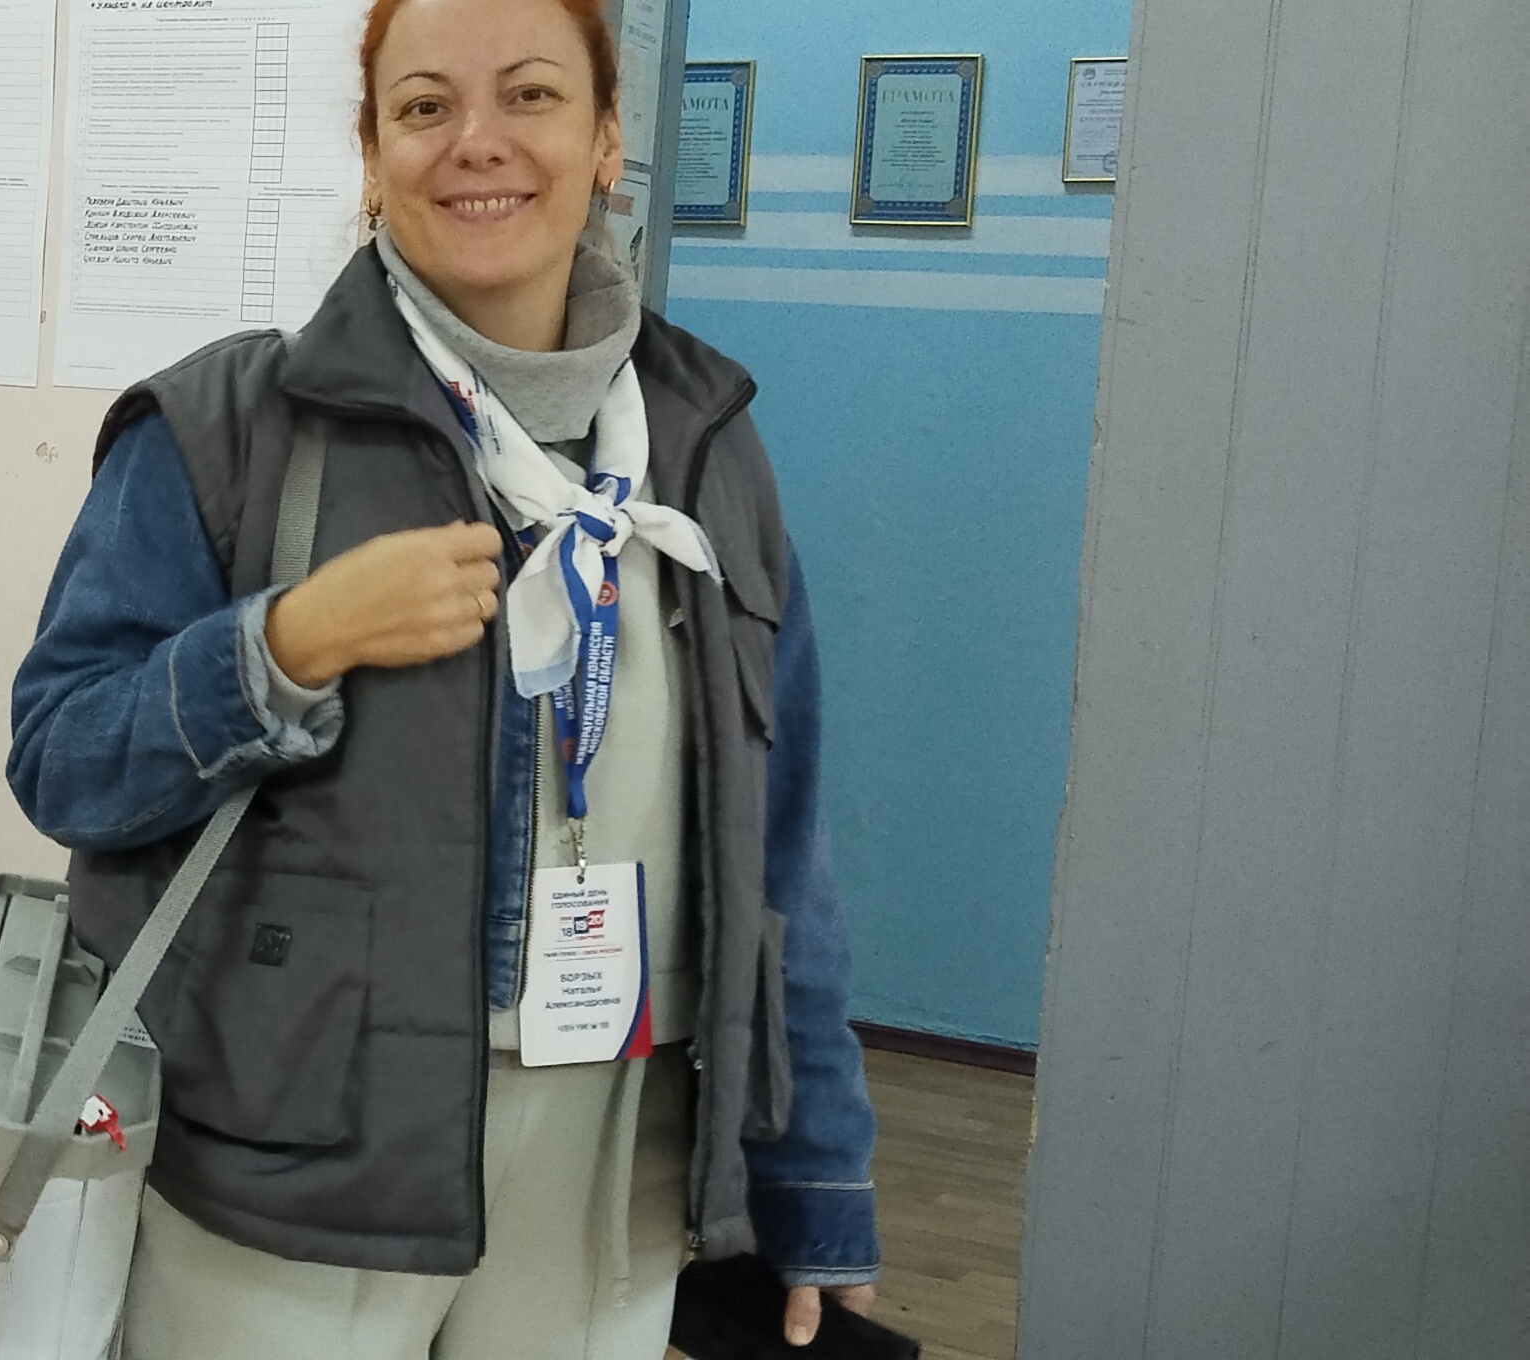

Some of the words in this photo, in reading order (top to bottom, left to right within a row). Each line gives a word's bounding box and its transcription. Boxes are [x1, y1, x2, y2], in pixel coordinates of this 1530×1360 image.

[881, 89, 955, 104] ГРАМОТА
[586, 621, 603, 679] КОМИССИЯ
[599, 635, 615, 683] ОБЛАСТИ
[587, 914, 602, 927] 20
[560, 971, 603, 983] БОРЗЫХ
